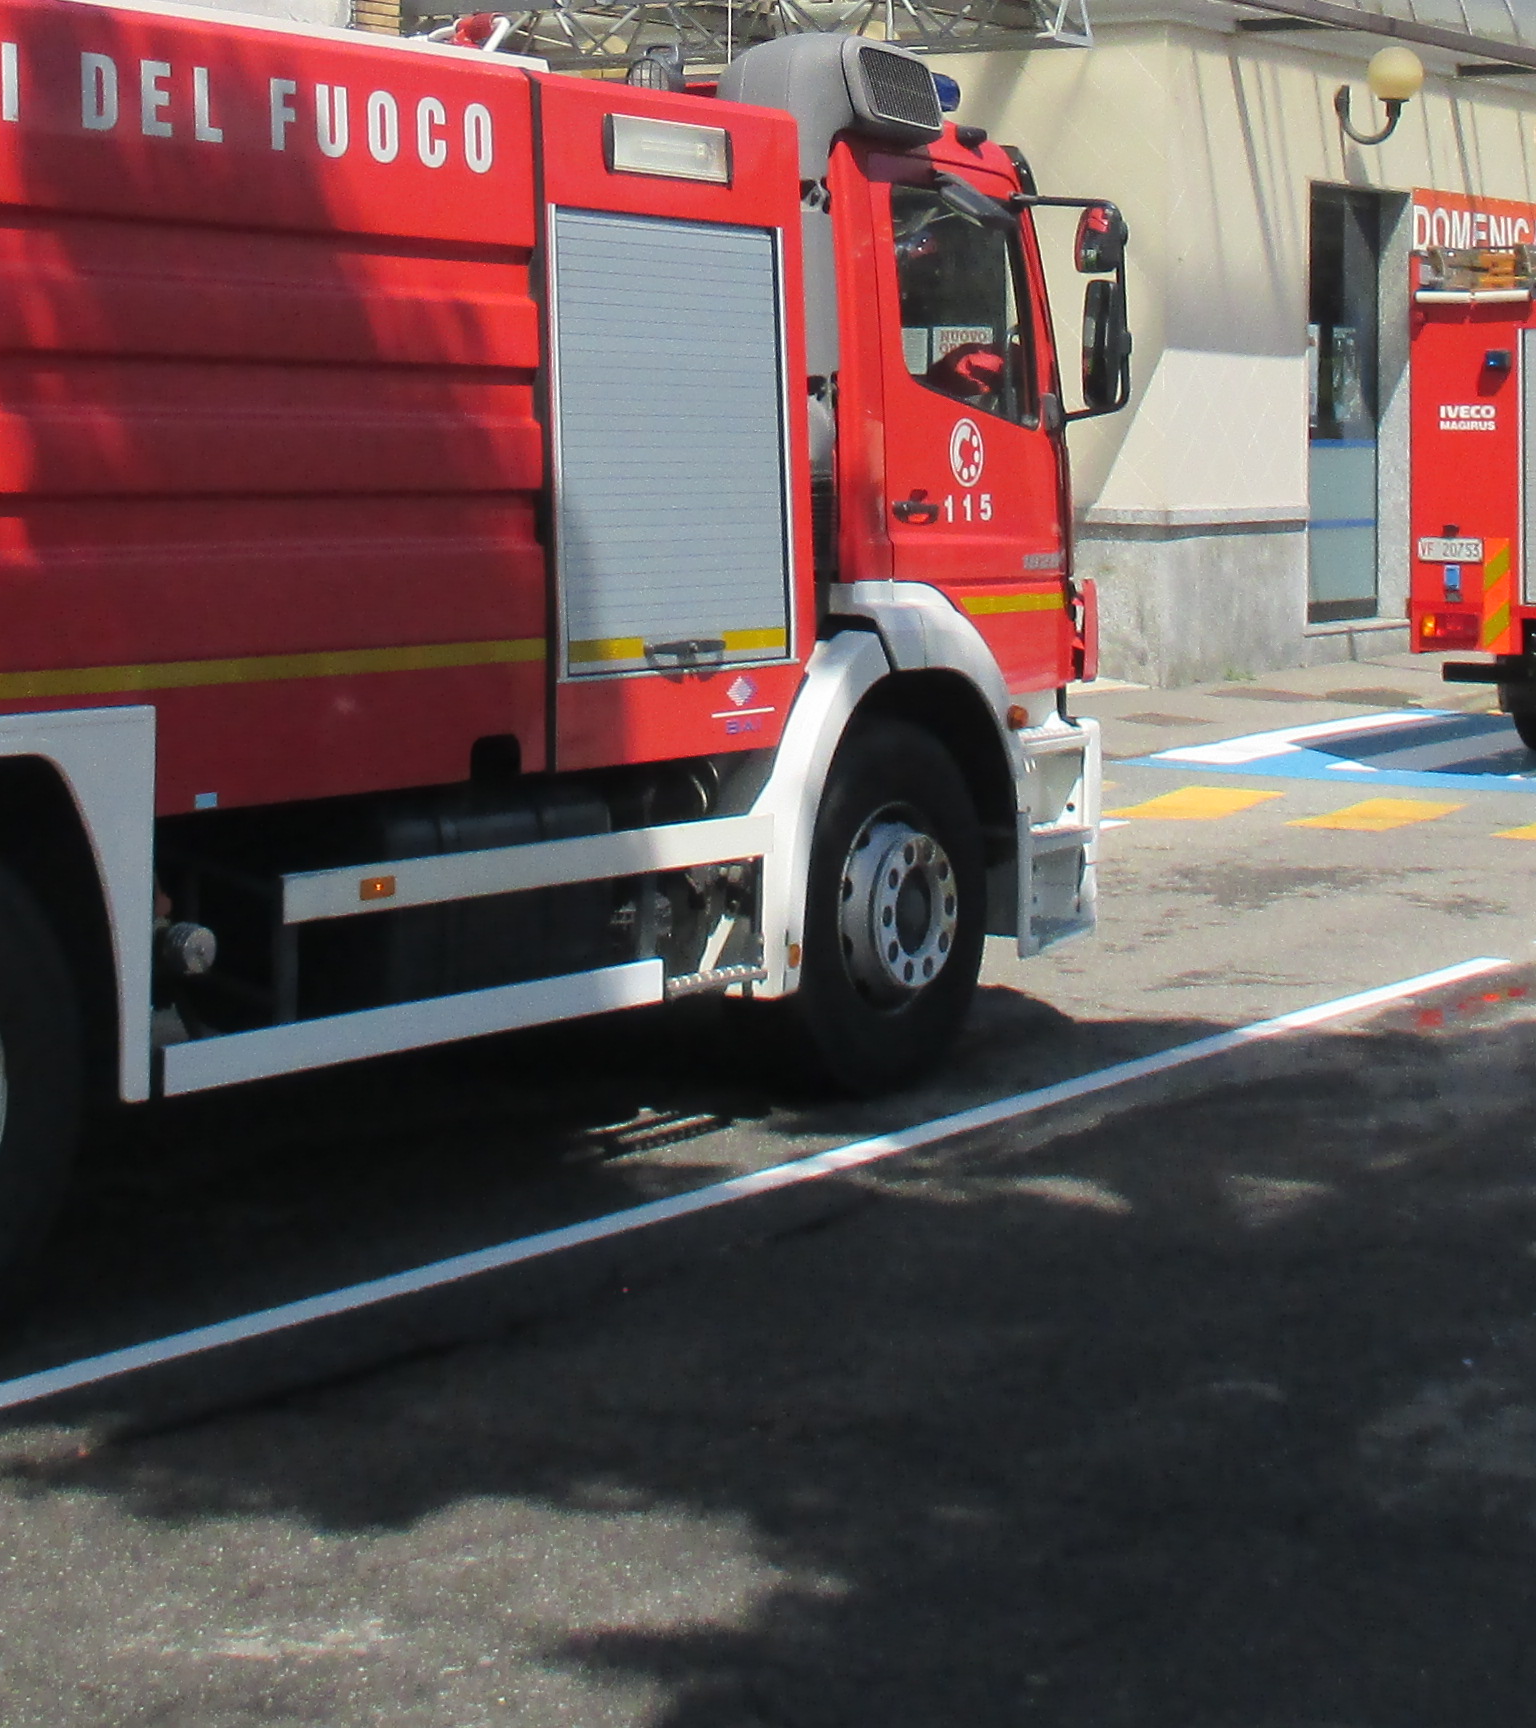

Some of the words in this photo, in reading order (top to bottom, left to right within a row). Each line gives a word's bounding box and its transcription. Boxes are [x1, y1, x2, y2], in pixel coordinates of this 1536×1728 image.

[81, 51, 224, 143] DEL
[270, 77, 494, 174] FUOCO
[1439, 405, 1496, 419] IVECO
[1439, 420, 1496, 431] MAGIRUS
[944, 493, 992, 523] 115
[1421, 541, 1435, 557] VF
